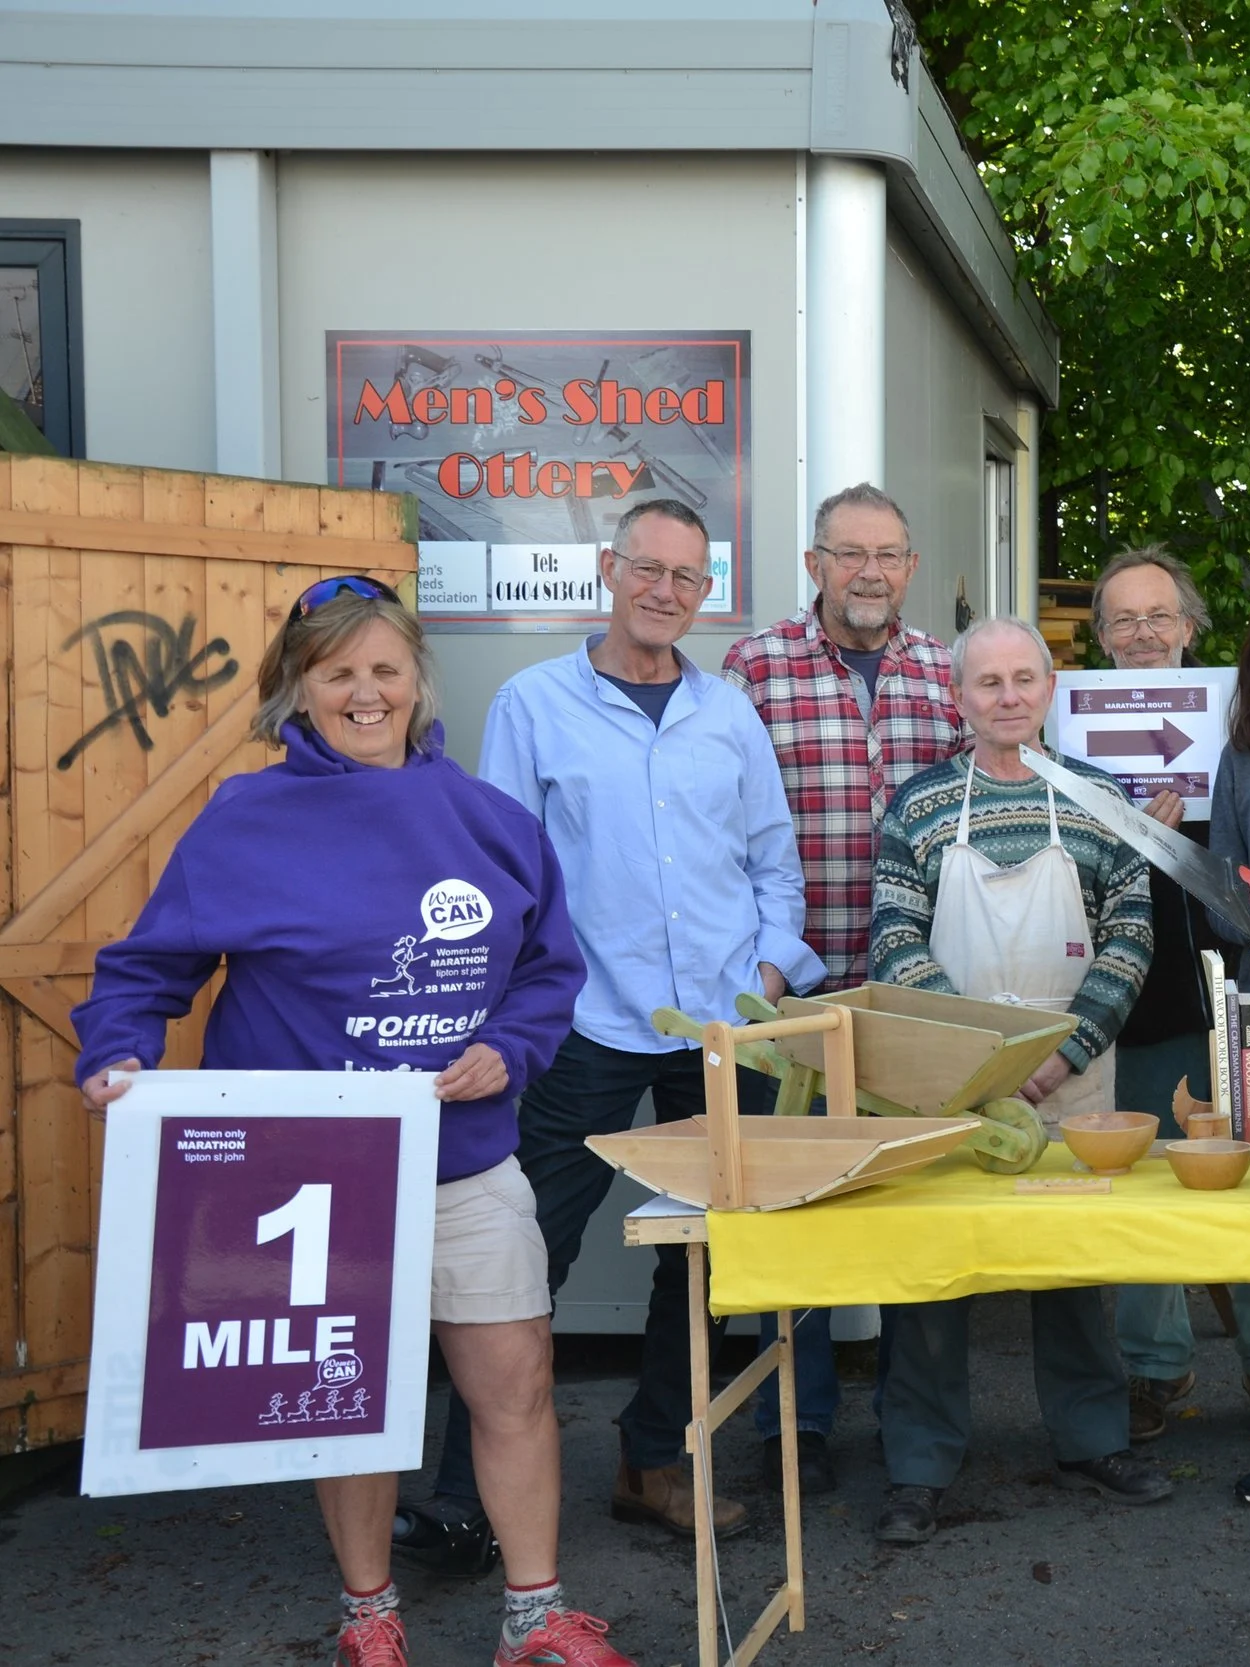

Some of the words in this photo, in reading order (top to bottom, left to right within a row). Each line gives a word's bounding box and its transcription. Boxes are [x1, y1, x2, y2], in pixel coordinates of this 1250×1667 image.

[354, 378, 547, 425] Men's
[562, 378, 725, 425] Shed
[438, 452, 646, 499] Ottery
[531, 553, 558, 573] Tel:
[712, 556, 729, 581] elp
[418, 565, 443, 576] en's
[418, 592, 478, 604] ssociation
[496, 581, 539, 601] 01404
[543, 581, 593, 601] 813041
[1105, 702, 1145, 710] MARATHON
[1118, 777, 1131, 785] ROU
[428, 891, 478, 906] Women
[430, 903, 483, 924] CAN
[436, 948, 470, 957] Women
[471, 945, 490, 955] only
[430, 955, 488, 967] MARATHON
[436, 968, 459, 979] tipton
[461, 968, 469, 976] st
[470, 967, 487, 977] john
[425, 984, 438, 994] 28
[441, 983, 463, 993] MAY
[466, 981, 485, 991] 2017
[1214, 976, 1223, 997] THE
[1230, 1014, 1238, 1028] THE
[1216, 998, 1228, 1063] WOODWORK
[378, 1038, 428, 1047] Business
[1231, 1030, 1240, 1077] CRAFTSMAN
[1219, 1067, 1229, 1097] BOOK
[1233, 1079, 1242, 1133] WOODTURNER
[184, 1129, 222, 1138] Women
[224, 1129, 246, 1140] only
[177, 1141, 246, 1150] MARATHON
[184, 1153, 211, 1163] tipton
[213, 1153, 222, 1161] st
[223, 1152, 245, 1163] john
[256, 1184, 332, 1306] 1
[183, 1315, 356, 1370] MILE
[324, 1359, 356, 1368] Women
[323, 1366, 356, 1379] CAN
